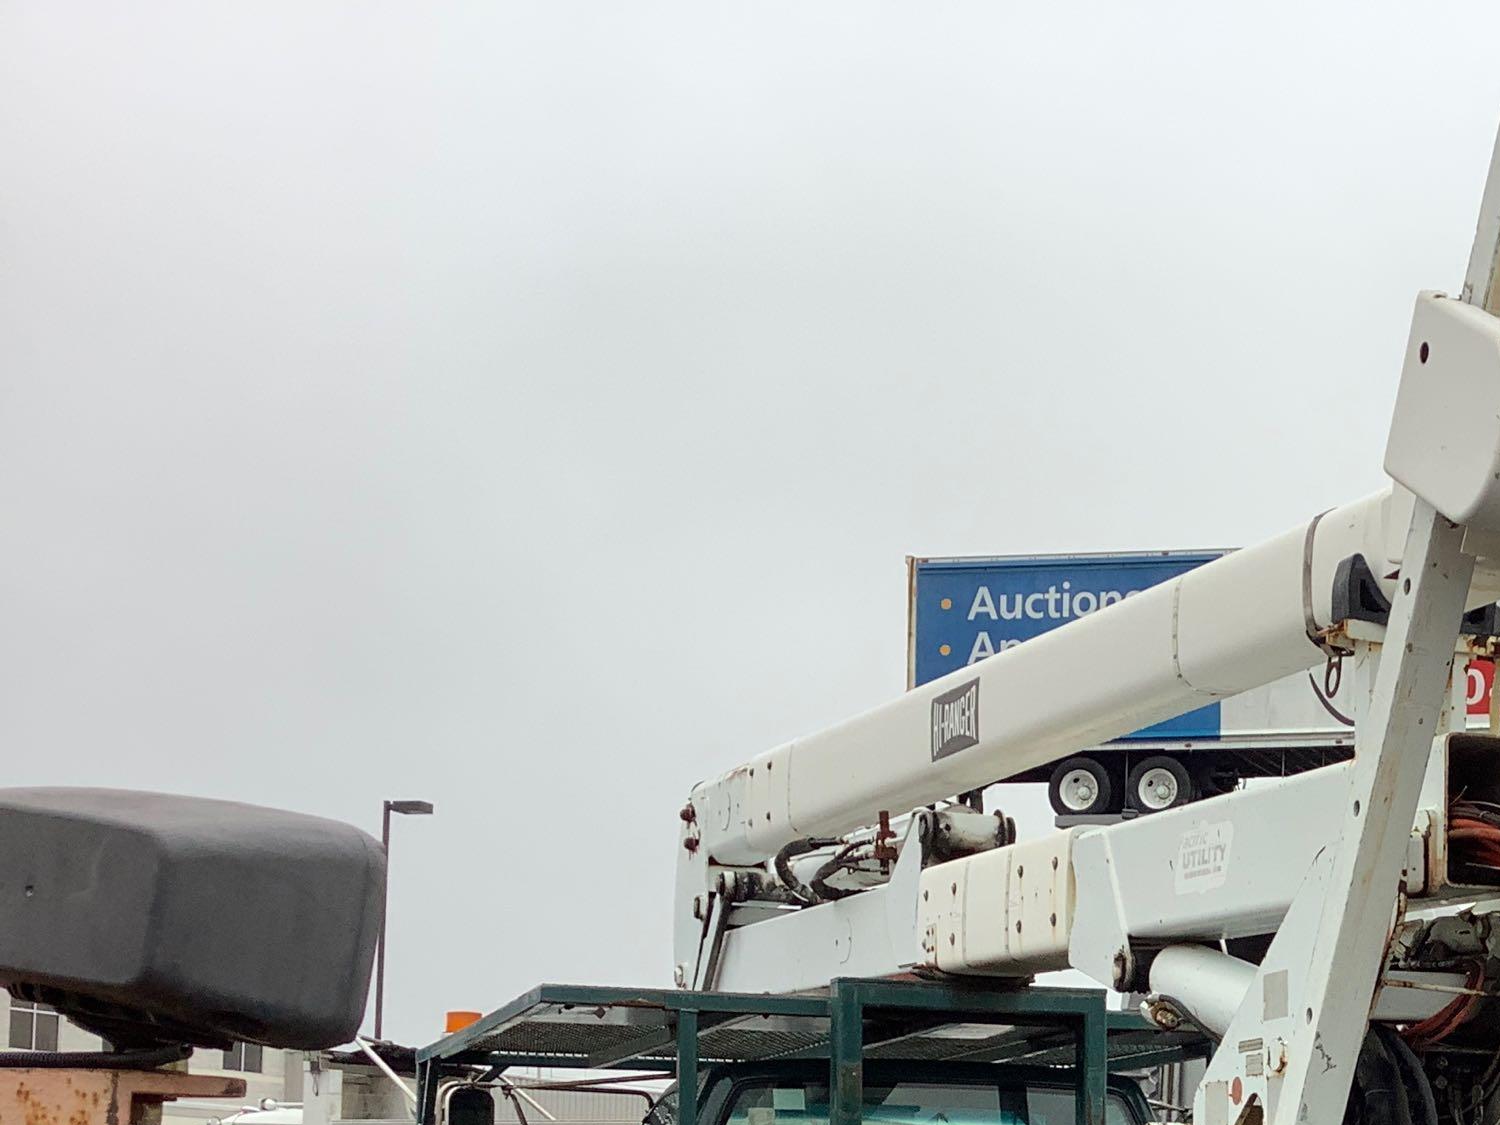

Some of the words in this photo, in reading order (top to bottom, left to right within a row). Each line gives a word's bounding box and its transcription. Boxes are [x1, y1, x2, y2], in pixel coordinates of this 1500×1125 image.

[967, 581, 1144, 620] Auction
[933, 683, 977, 757] HI-RANGER
[1182, 844, 1227, 869] UTILITY
